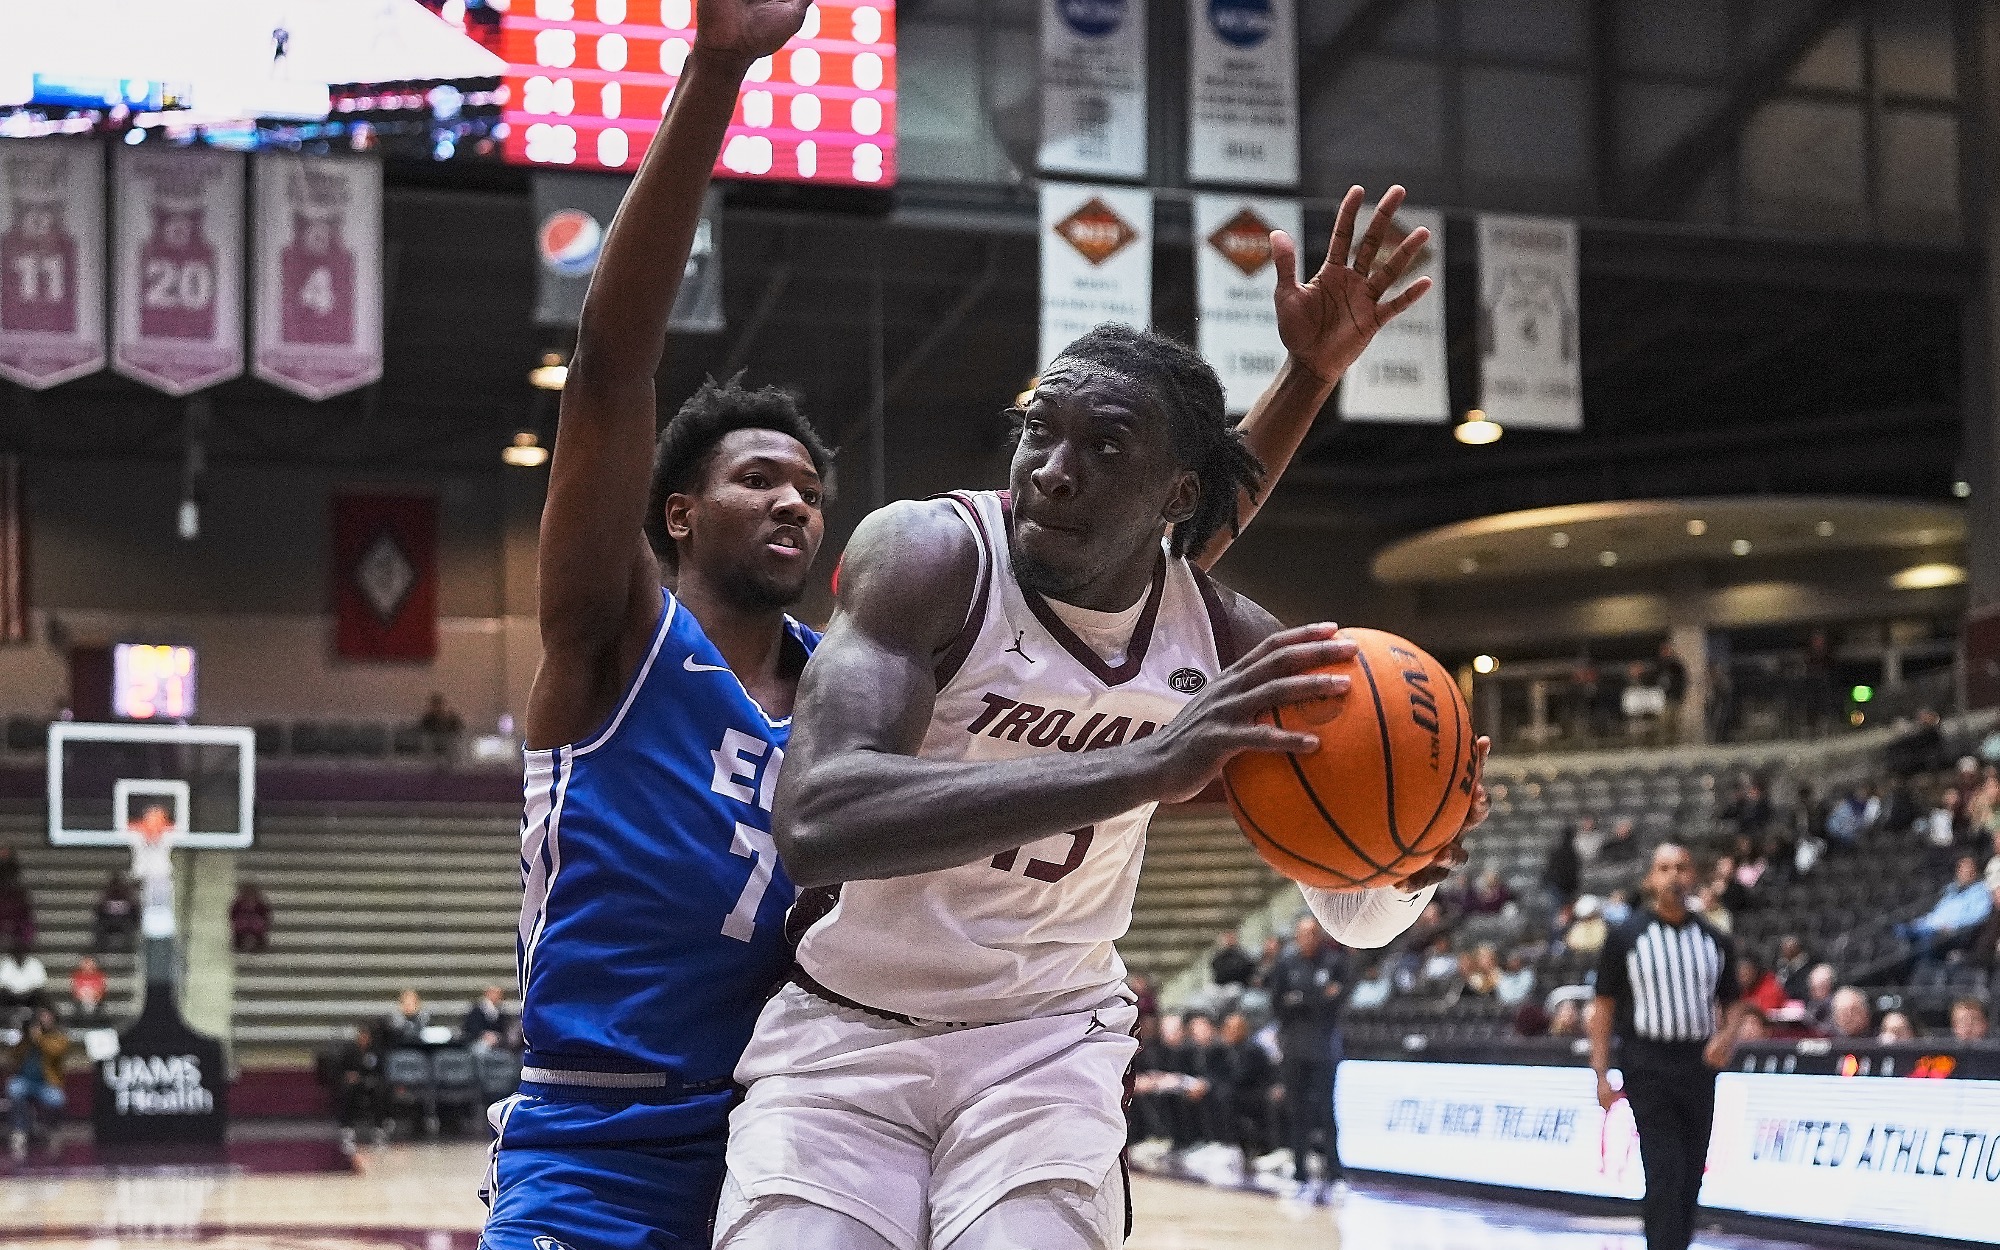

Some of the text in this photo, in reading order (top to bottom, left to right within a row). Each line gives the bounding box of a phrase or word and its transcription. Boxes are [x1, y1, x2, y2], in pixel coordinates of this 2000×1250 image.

[601, 81, 622, 120] 1
[796, 140, 817, 178] 1
[14, 256, 66, 301] 11
[146, 260, 211, 309] 20
[302, 267, 333, 314] 4
[720, 821, 778, 943] 7
[1752, 1118, 1850, 1167] UNITED
